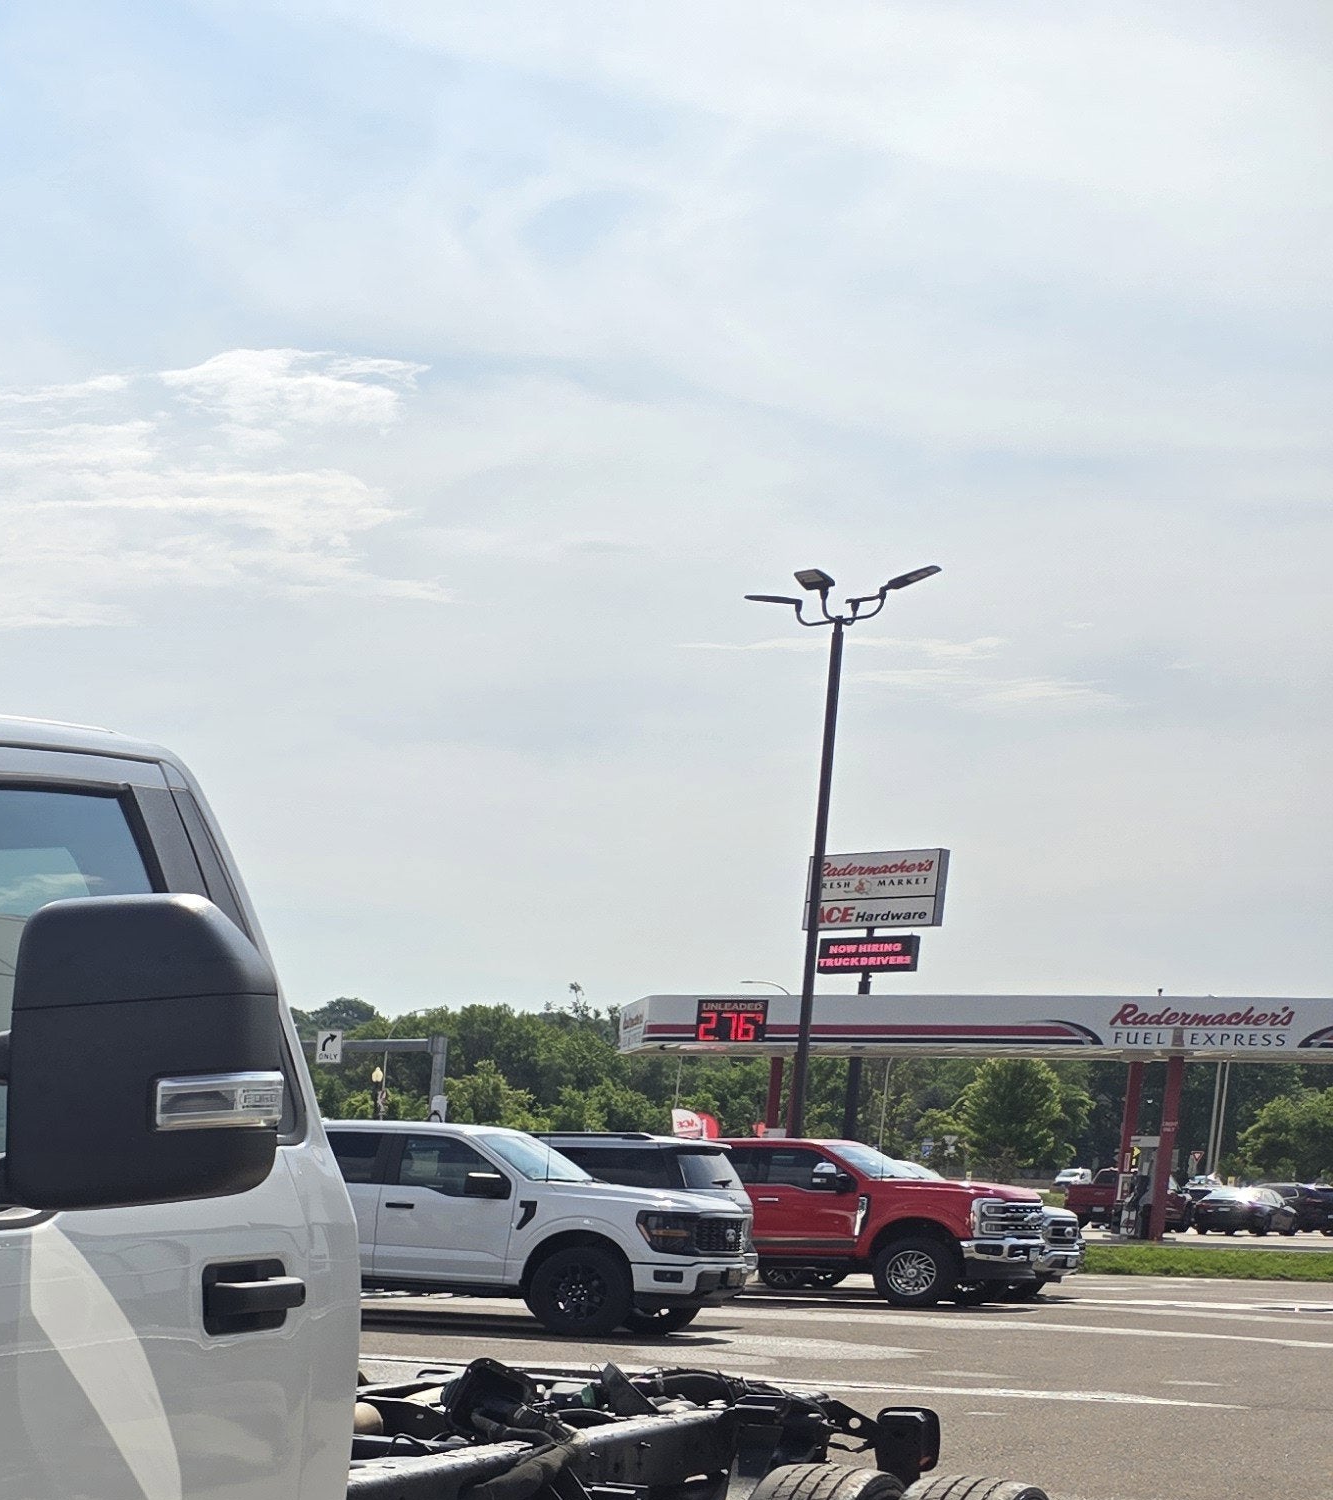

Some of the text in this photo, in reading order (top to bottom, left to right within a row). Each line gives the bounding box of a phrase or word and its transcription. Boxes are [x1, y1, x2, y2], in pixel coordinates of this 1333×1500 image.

[821, 877, 928, 890] RESH MARKET
[855, 910, 927, 923] Hardware
[829, 943, 902, 954] NOW HIRING
[818, 955, 911, 967] TRUCK DRIVERS
[703, 1003, 764, 1011] UNLEADED
[1110, 1003, 1295, 1027] Radermacher's
[1114, 1032, 1286, 1047] FUEL EXPRESS
